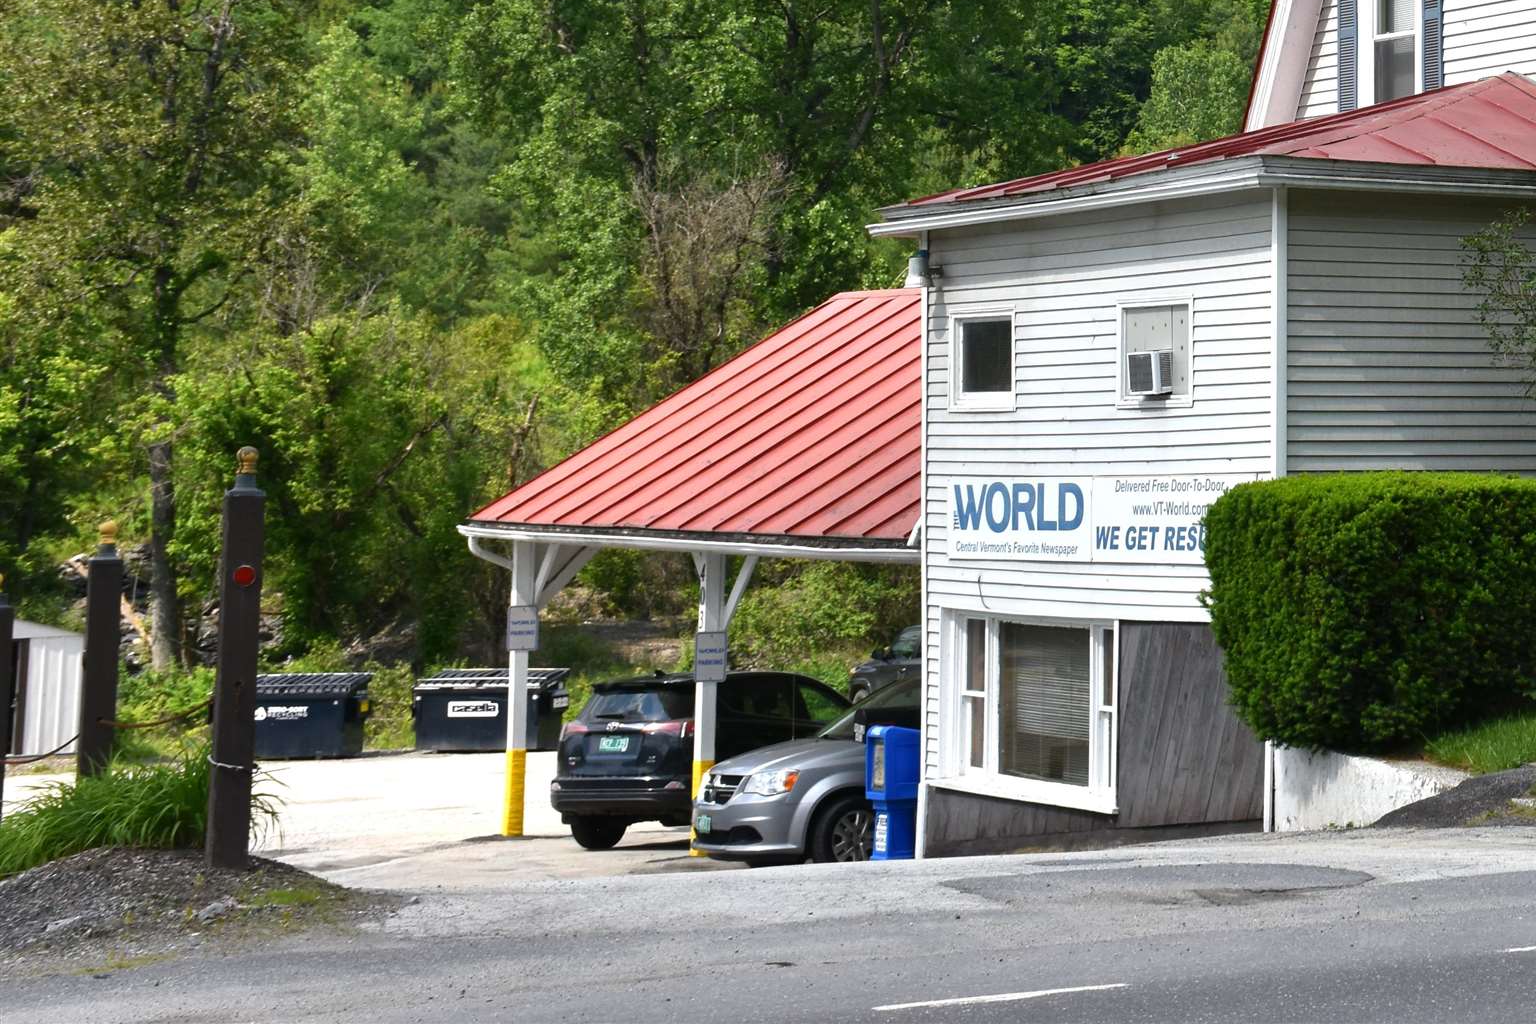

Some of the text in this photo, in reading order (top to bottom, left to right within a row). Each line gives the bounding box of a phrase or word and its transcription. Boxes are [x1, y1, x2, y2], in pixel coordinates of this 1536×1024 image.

[1115, 478, 1224, 492] Delivered Free Door-To-Door
[954, 482, 1084, 533] WORLD
[1096, 526, 1120, 550] WE
[1125, 526, 1160, 550] GET
[956, 541, 1079, 556] Central Vermont's Favorite Newspaper
